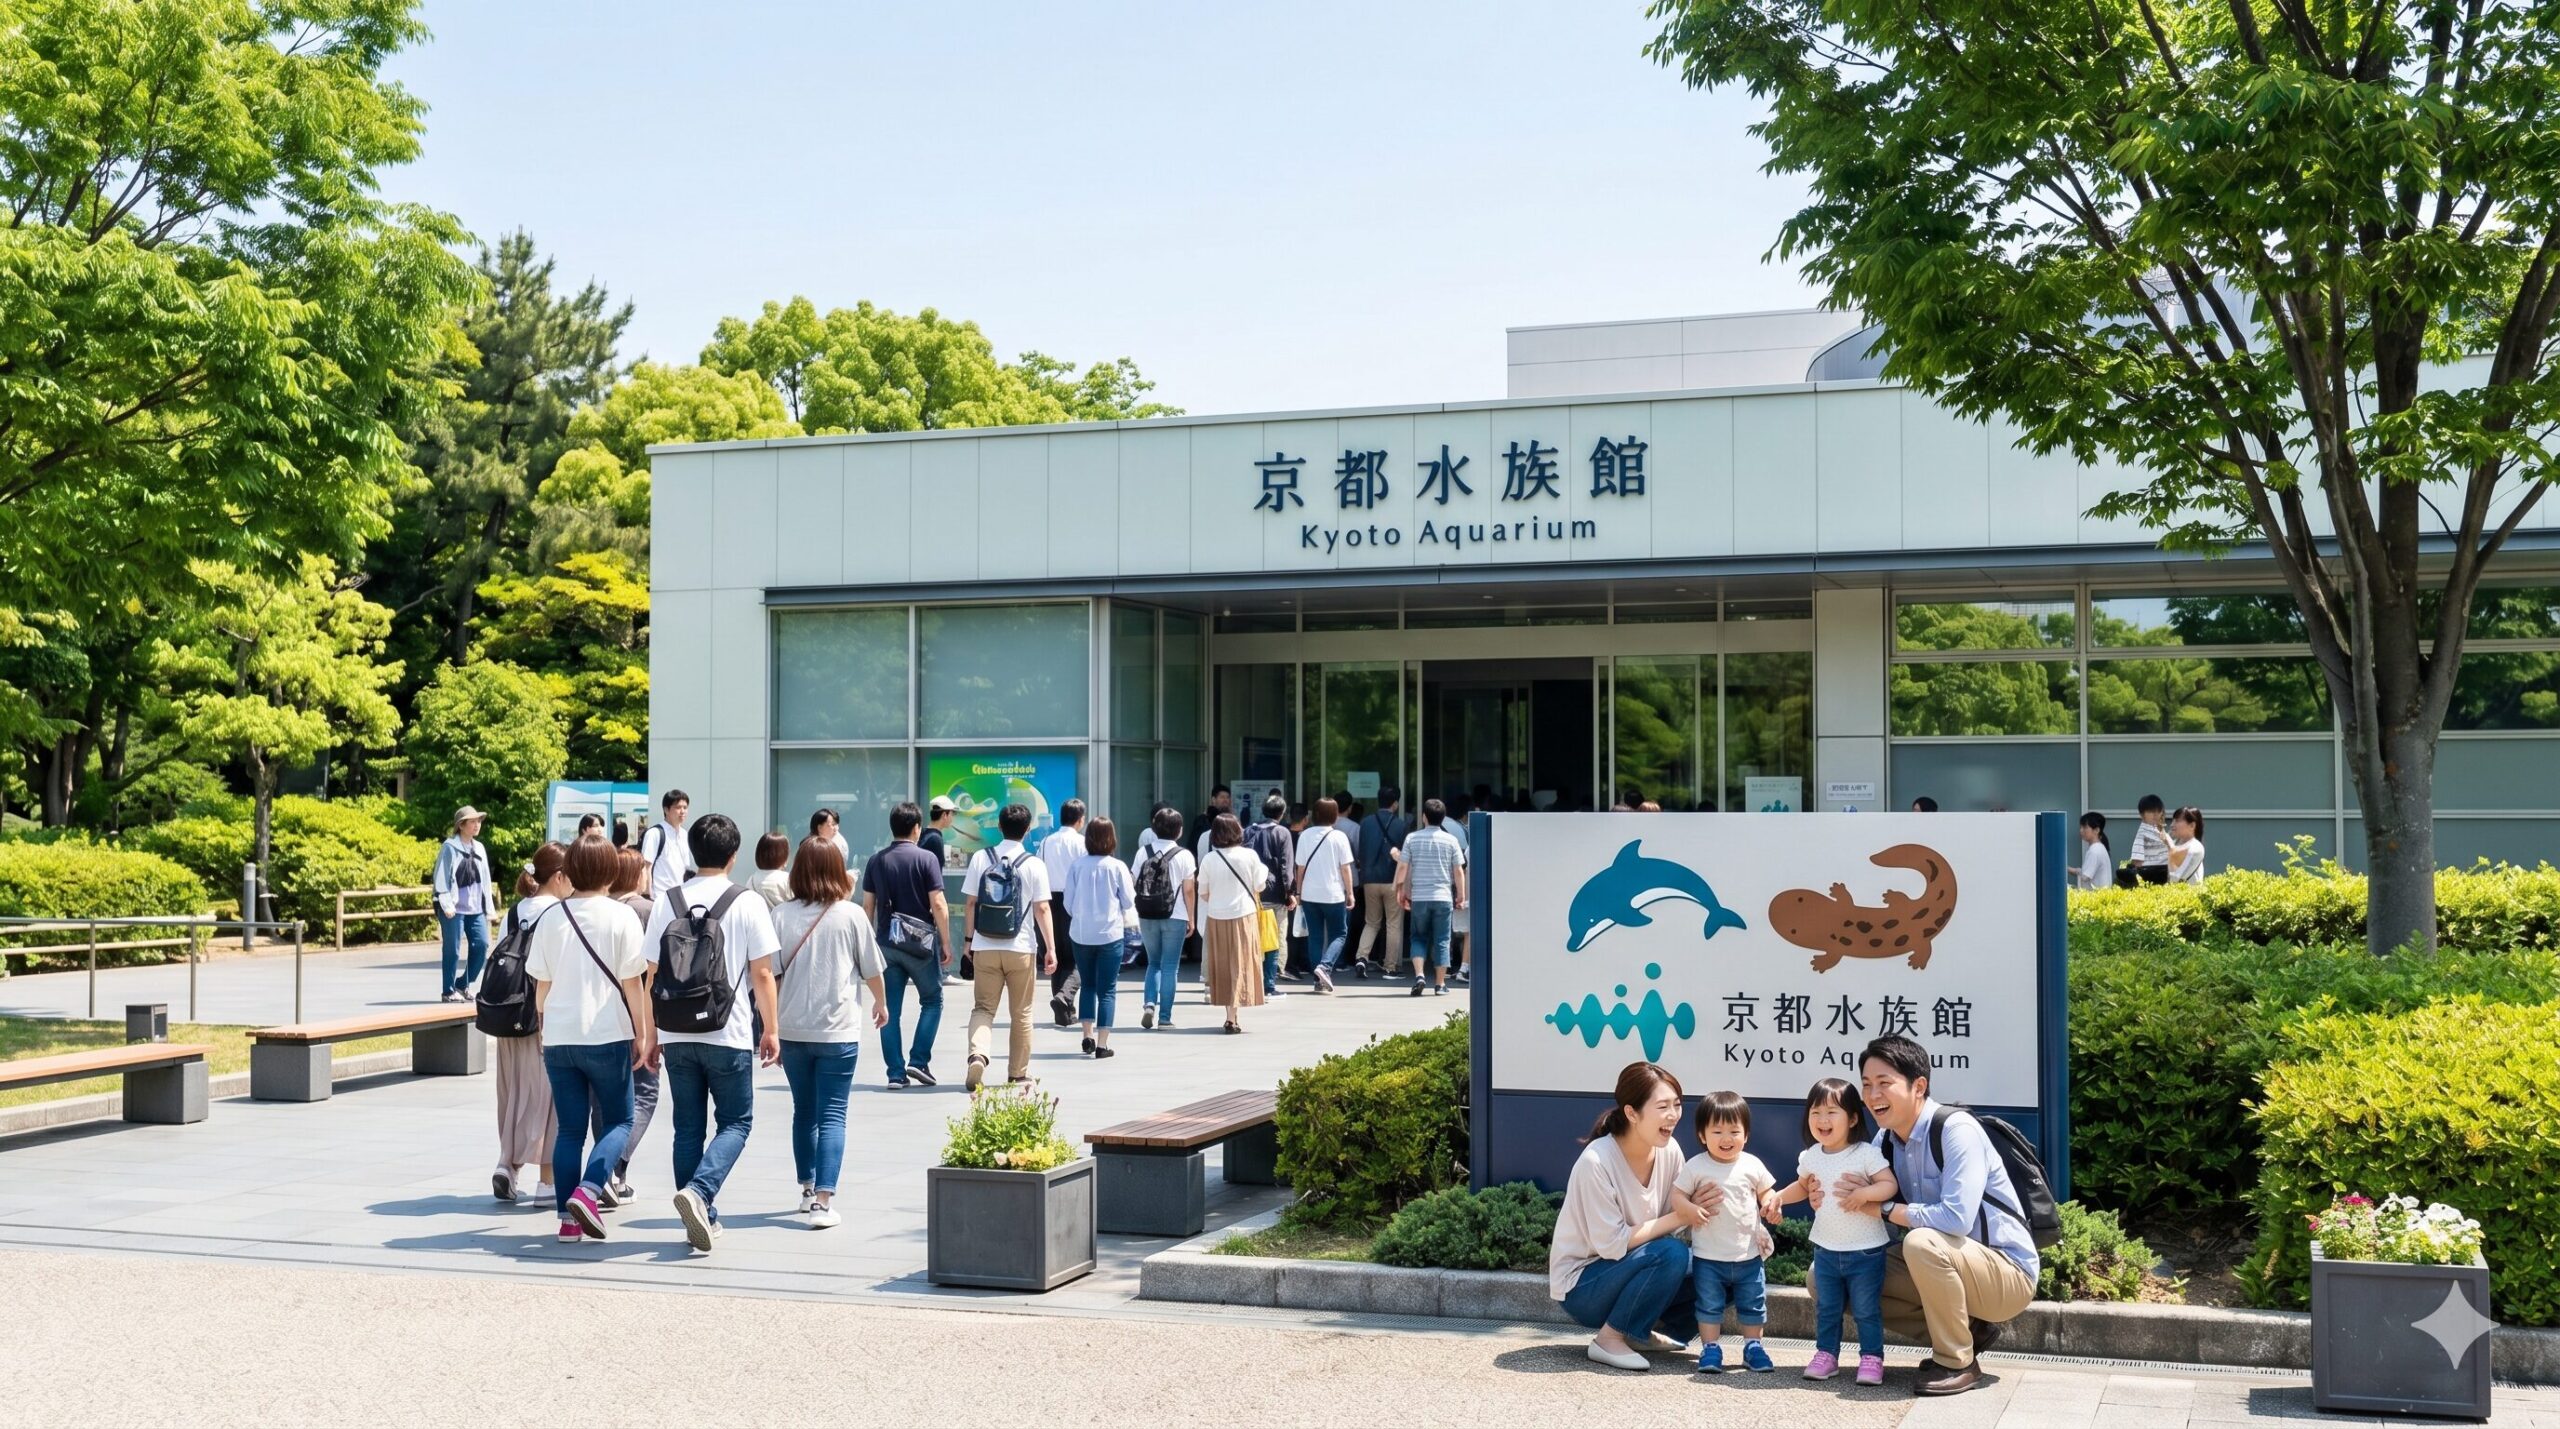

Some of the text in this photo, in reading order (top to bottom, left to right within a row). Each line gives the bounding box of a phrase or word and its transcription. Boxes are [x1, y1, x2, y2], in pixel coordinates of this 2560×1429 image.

[1253, 435, 1648, 512] 京都水族館
[1301, 515, 1597, 554] Kyoto Aquarium
[1722, 992, 1972, 1037] 京都水族館
[1724, 1043, 1970, 1071] Kyoto Aqum
